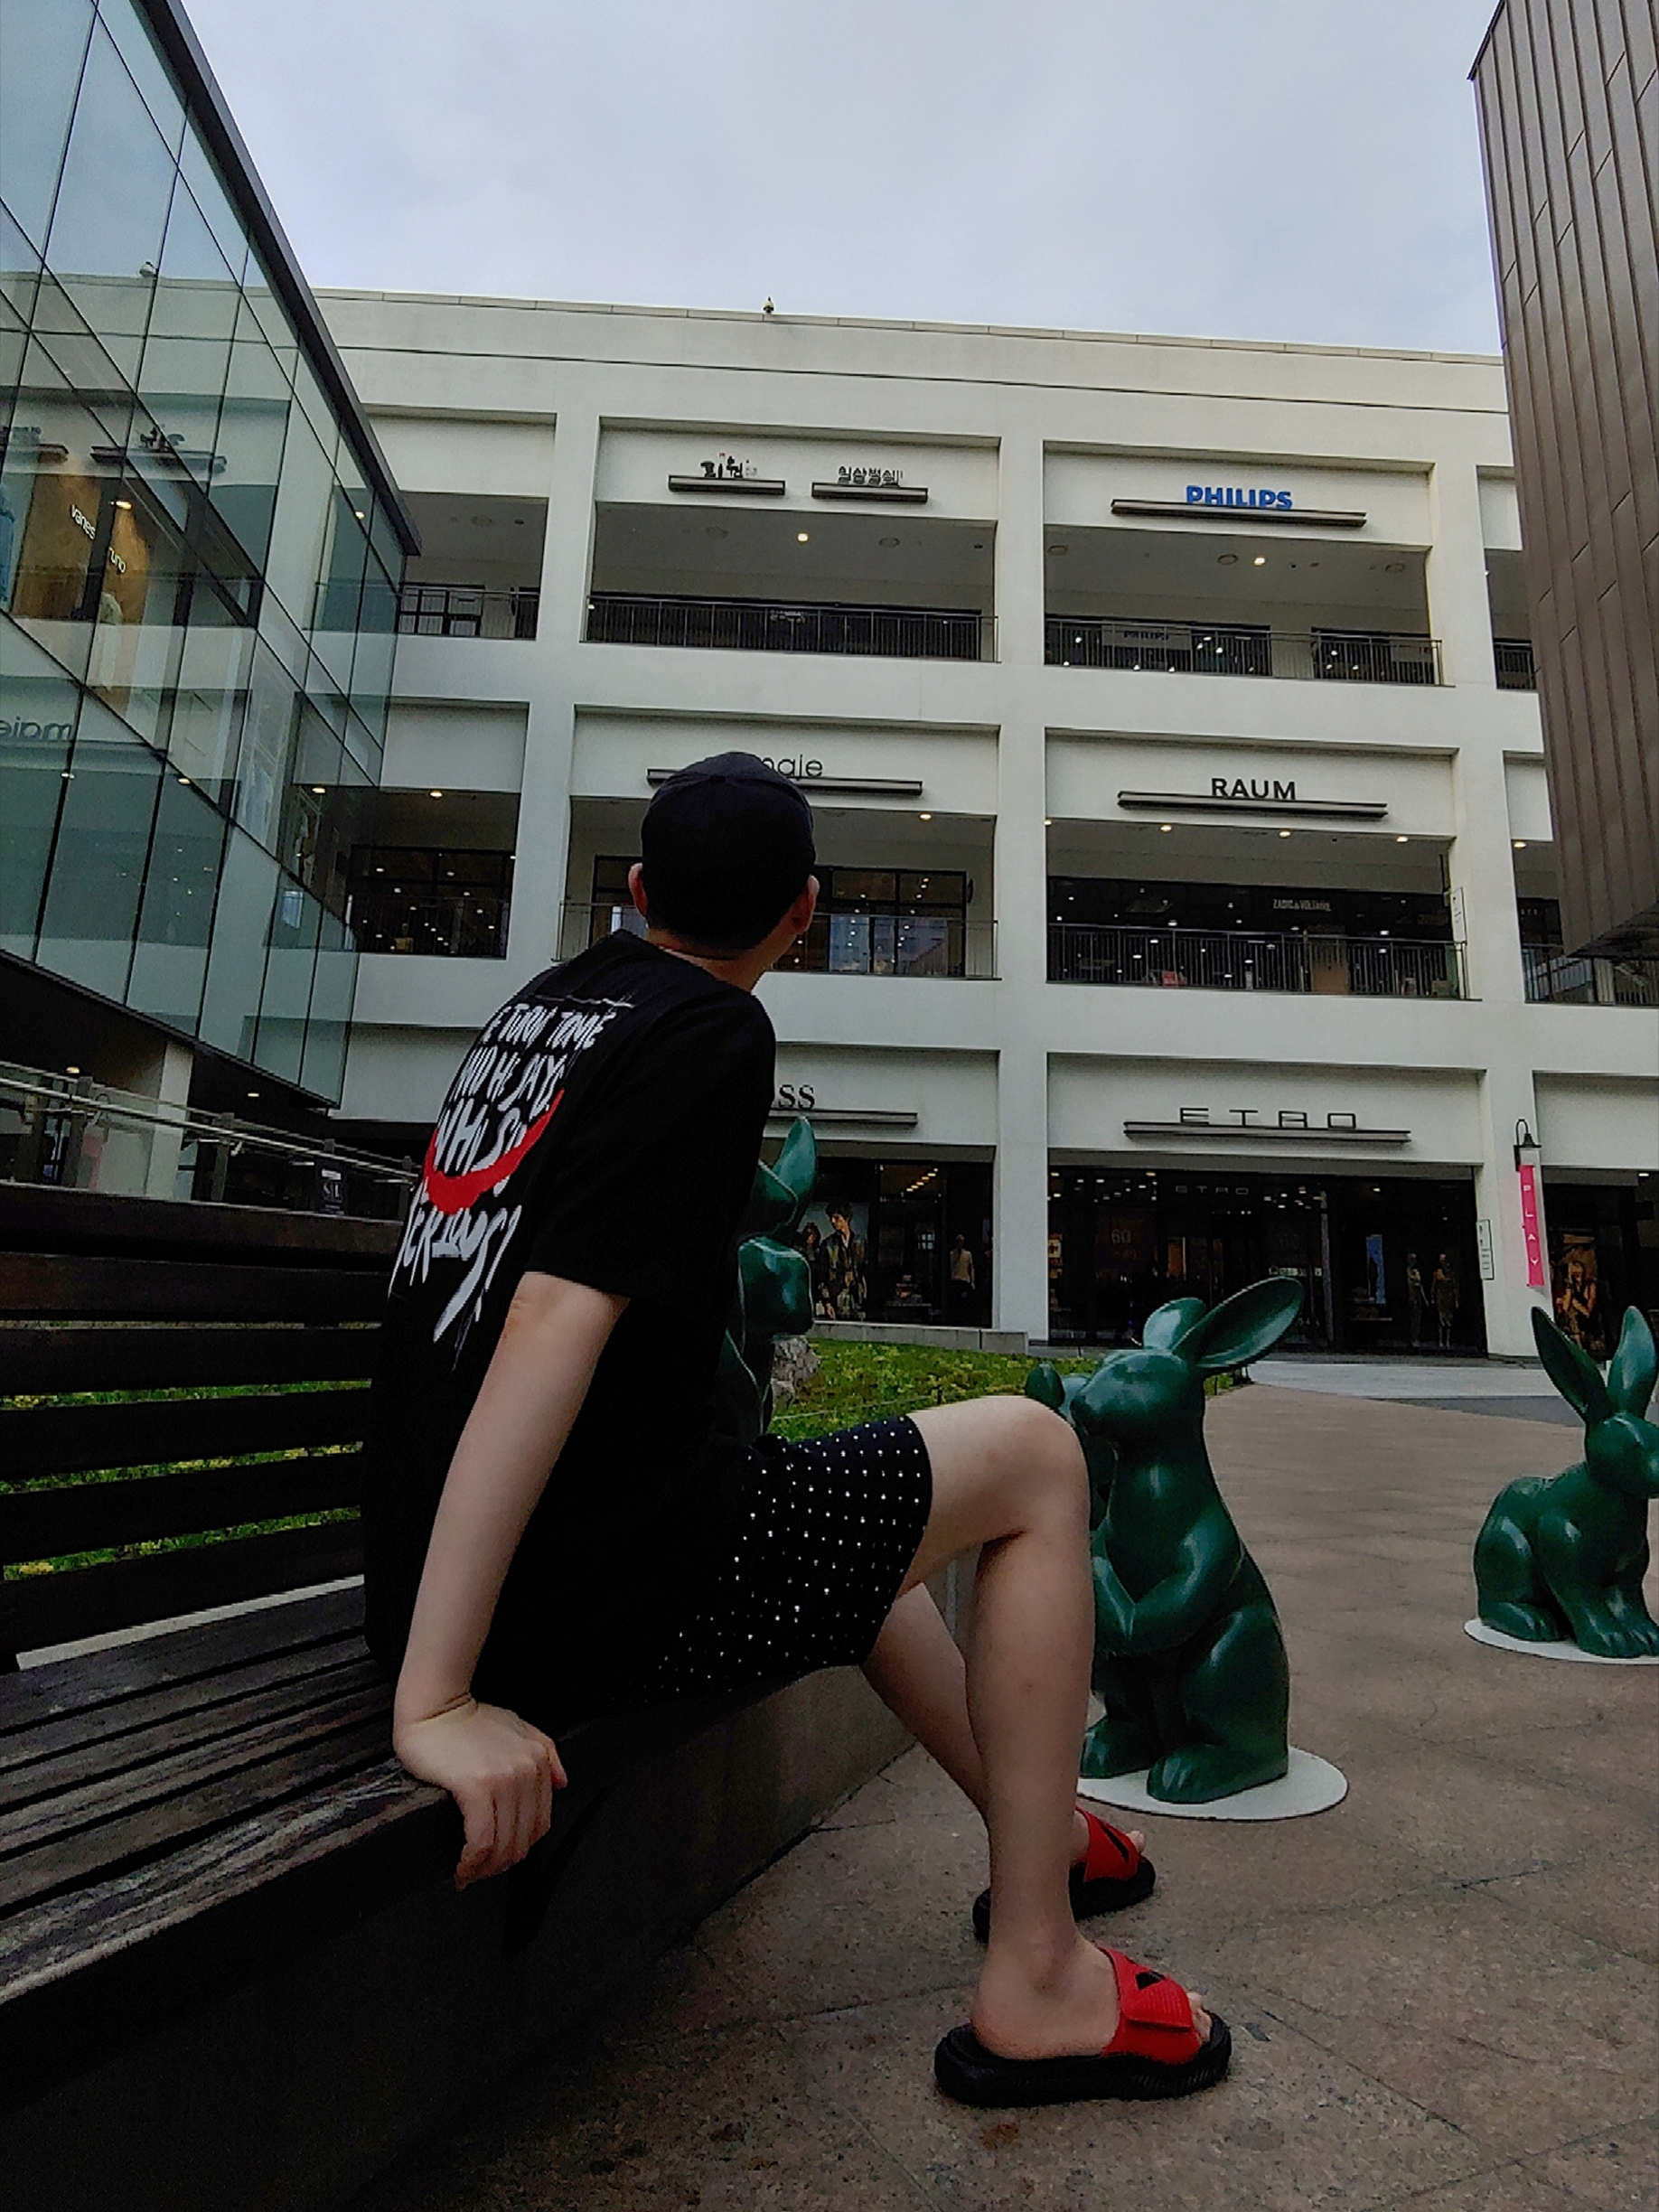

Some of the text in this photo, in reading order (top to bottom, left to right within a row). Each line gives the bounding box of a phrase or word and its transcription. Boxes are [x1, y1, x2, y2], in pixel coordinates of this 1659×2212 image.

[1186, 485, 1293, 510] PHILIPS
[1211, 777, 1297, 801] RAUM
[777, 1084, 816, 1110] SS
[1179, 1107, 1356, 1129] ETRO
[1523, 1185, 1540, 1266] PLAY
